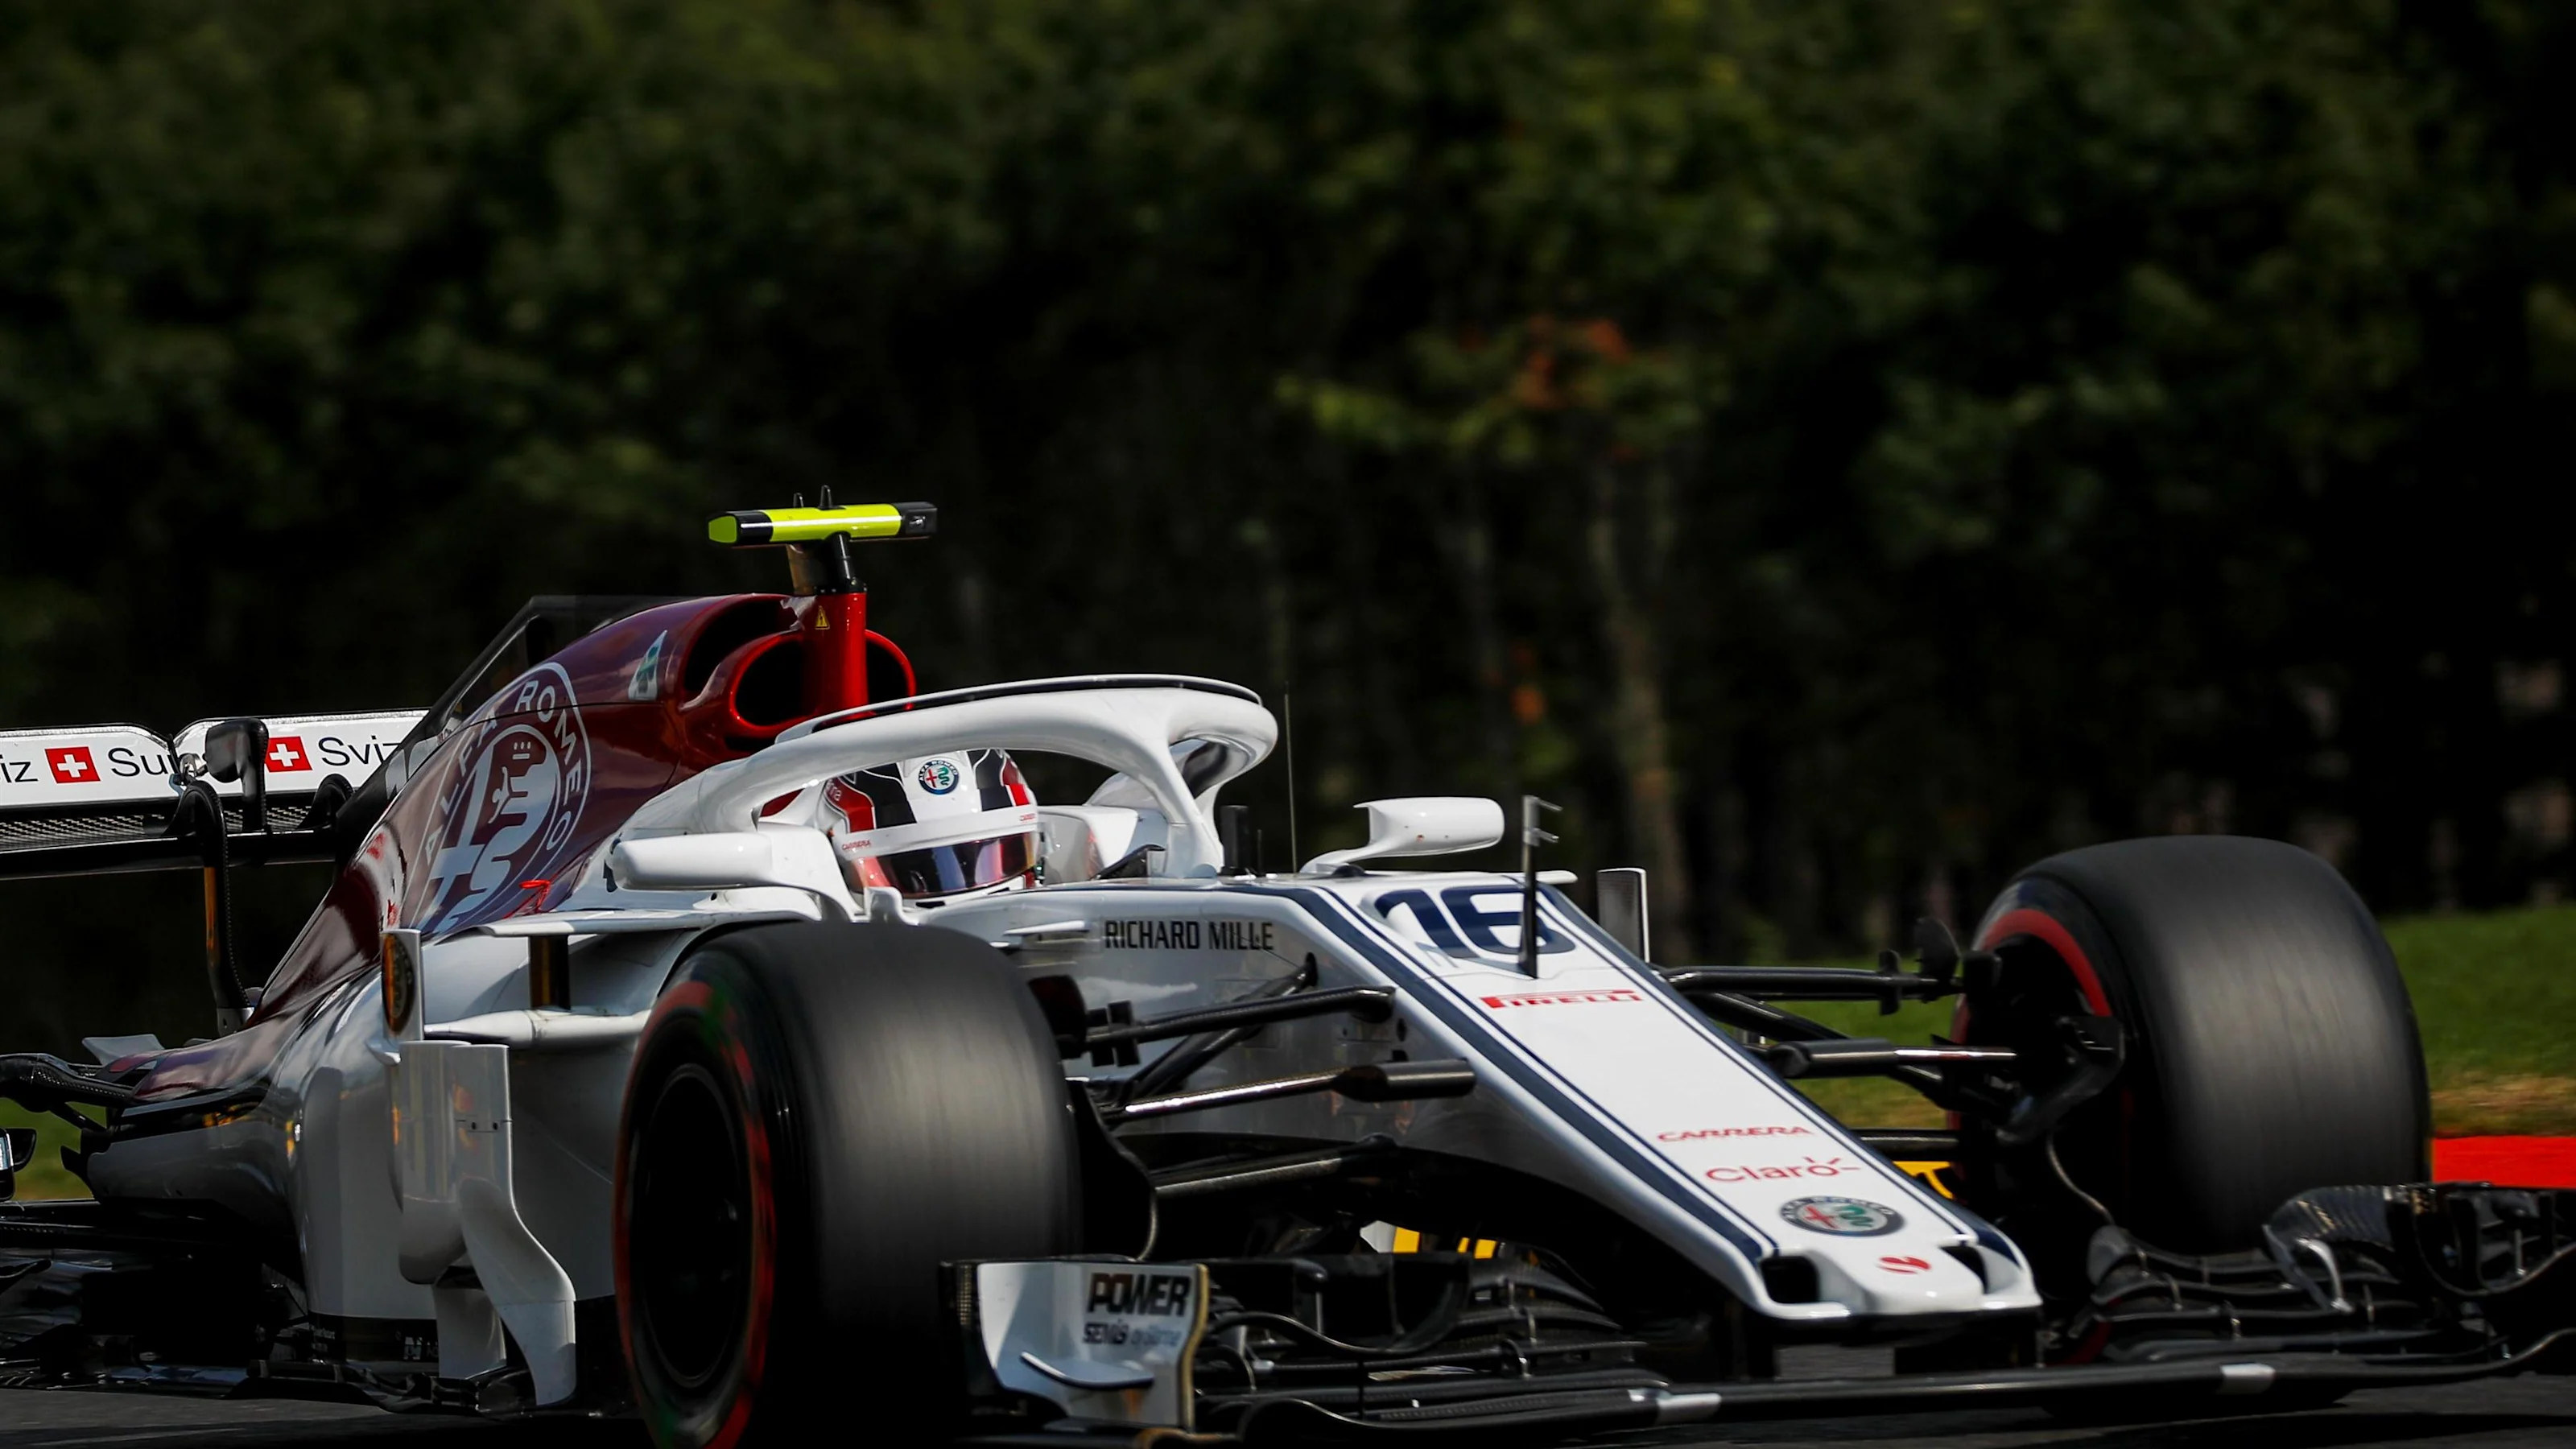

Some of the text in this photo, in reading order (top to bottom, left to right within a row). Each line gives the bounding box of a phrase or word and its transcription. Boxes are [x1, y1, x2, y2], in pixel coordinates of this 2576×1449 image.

[424, 679, 583, 867] ALFA ROMEO
[919, 760, 958, 782] ALFA ROMEO
[1104, 920, 1274, 951] RICHARD MILLE
[1374, 885, 1576, 959] 16
[1480, 989, 1643, 1009] PIRELLI
[1657, 1125, 1813, 1142] CARRERA
[1706, 1156, 1843, 1183] Claro
[1088, 1273, 1191, 1318] POWER
